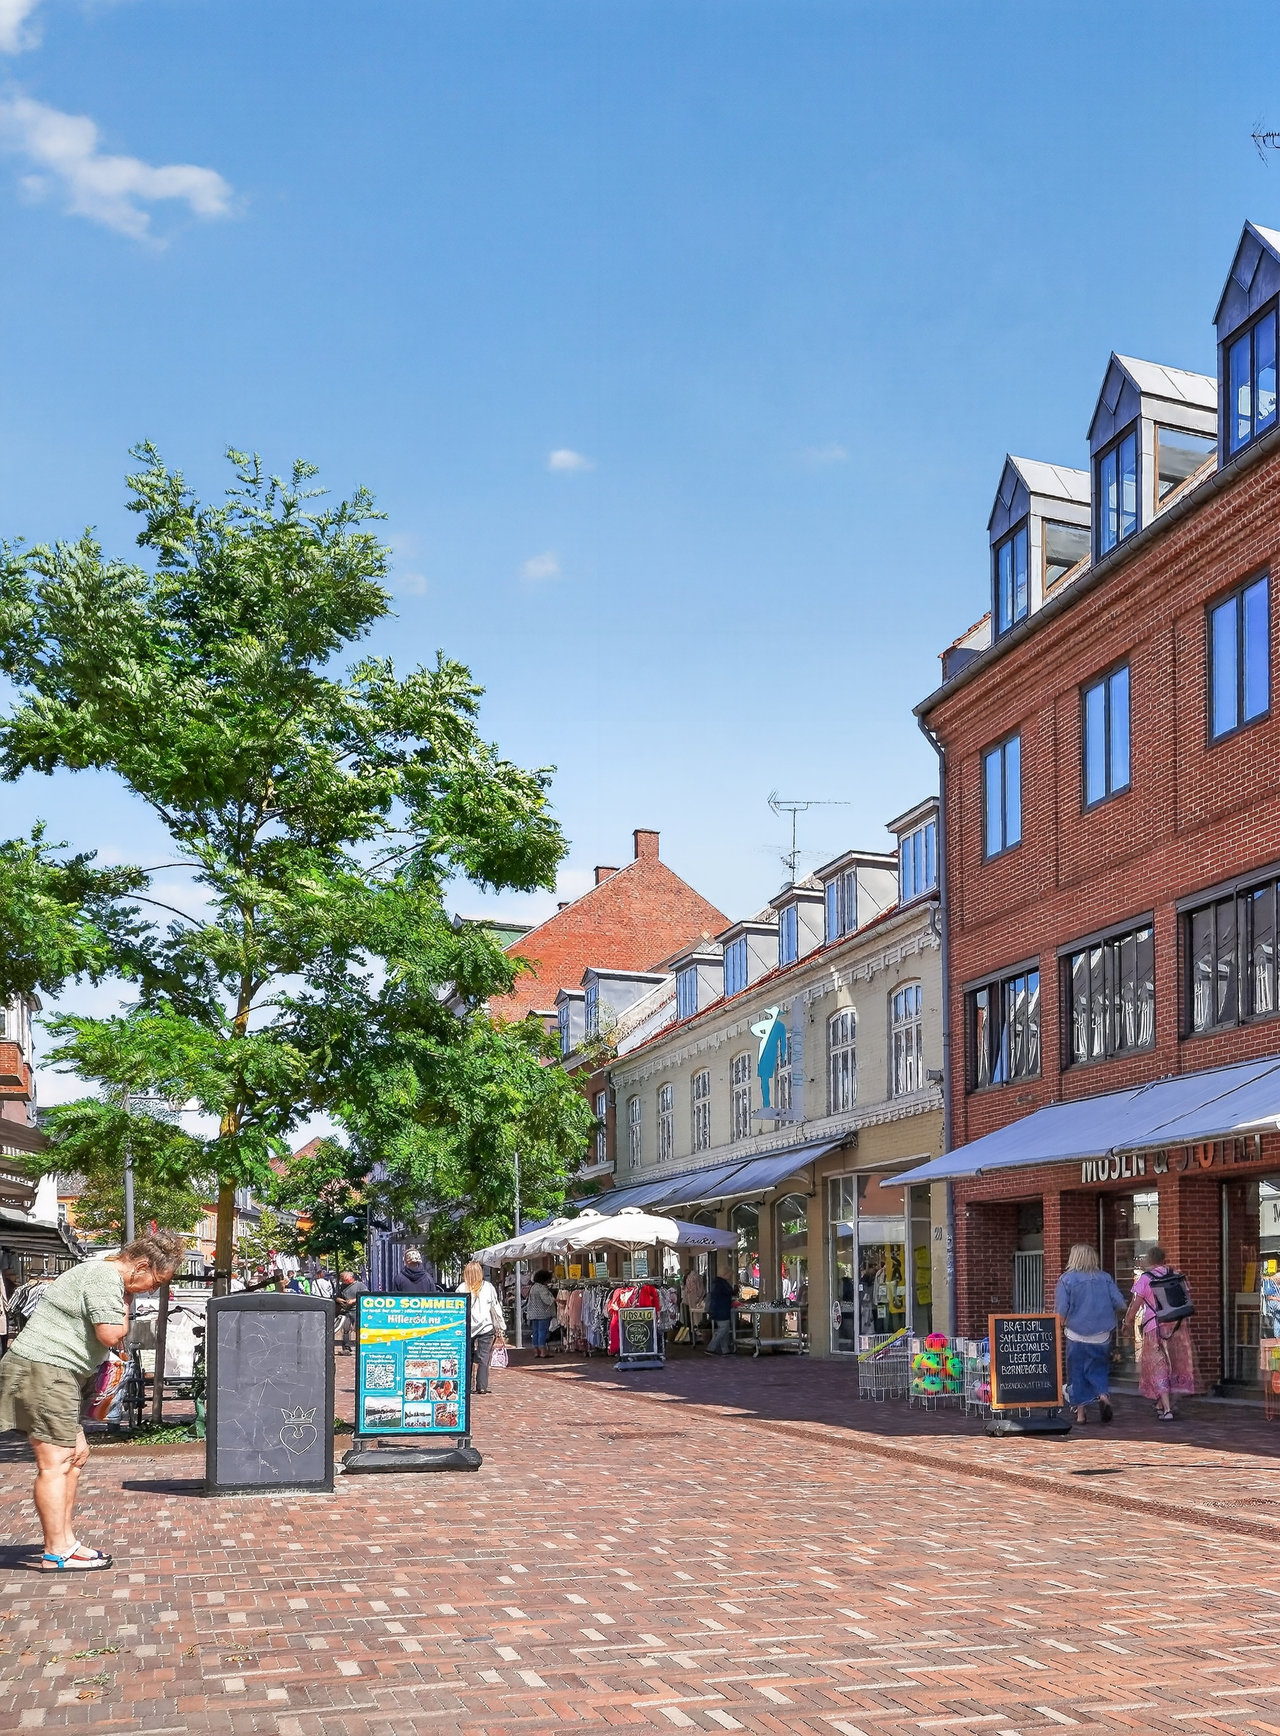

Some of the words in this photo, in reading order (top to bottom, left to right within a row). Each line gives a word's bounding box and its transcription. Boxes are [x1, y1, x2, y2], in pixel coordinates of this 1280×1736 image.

[362, 1298, 396, 1308] GOD
[400, 1298, 465, 1309] SOMMER
[1003, 1320, 1044, 1331] BRÆTSPIL
[1009, 1352, 1041, 1363] LEGETØJ
